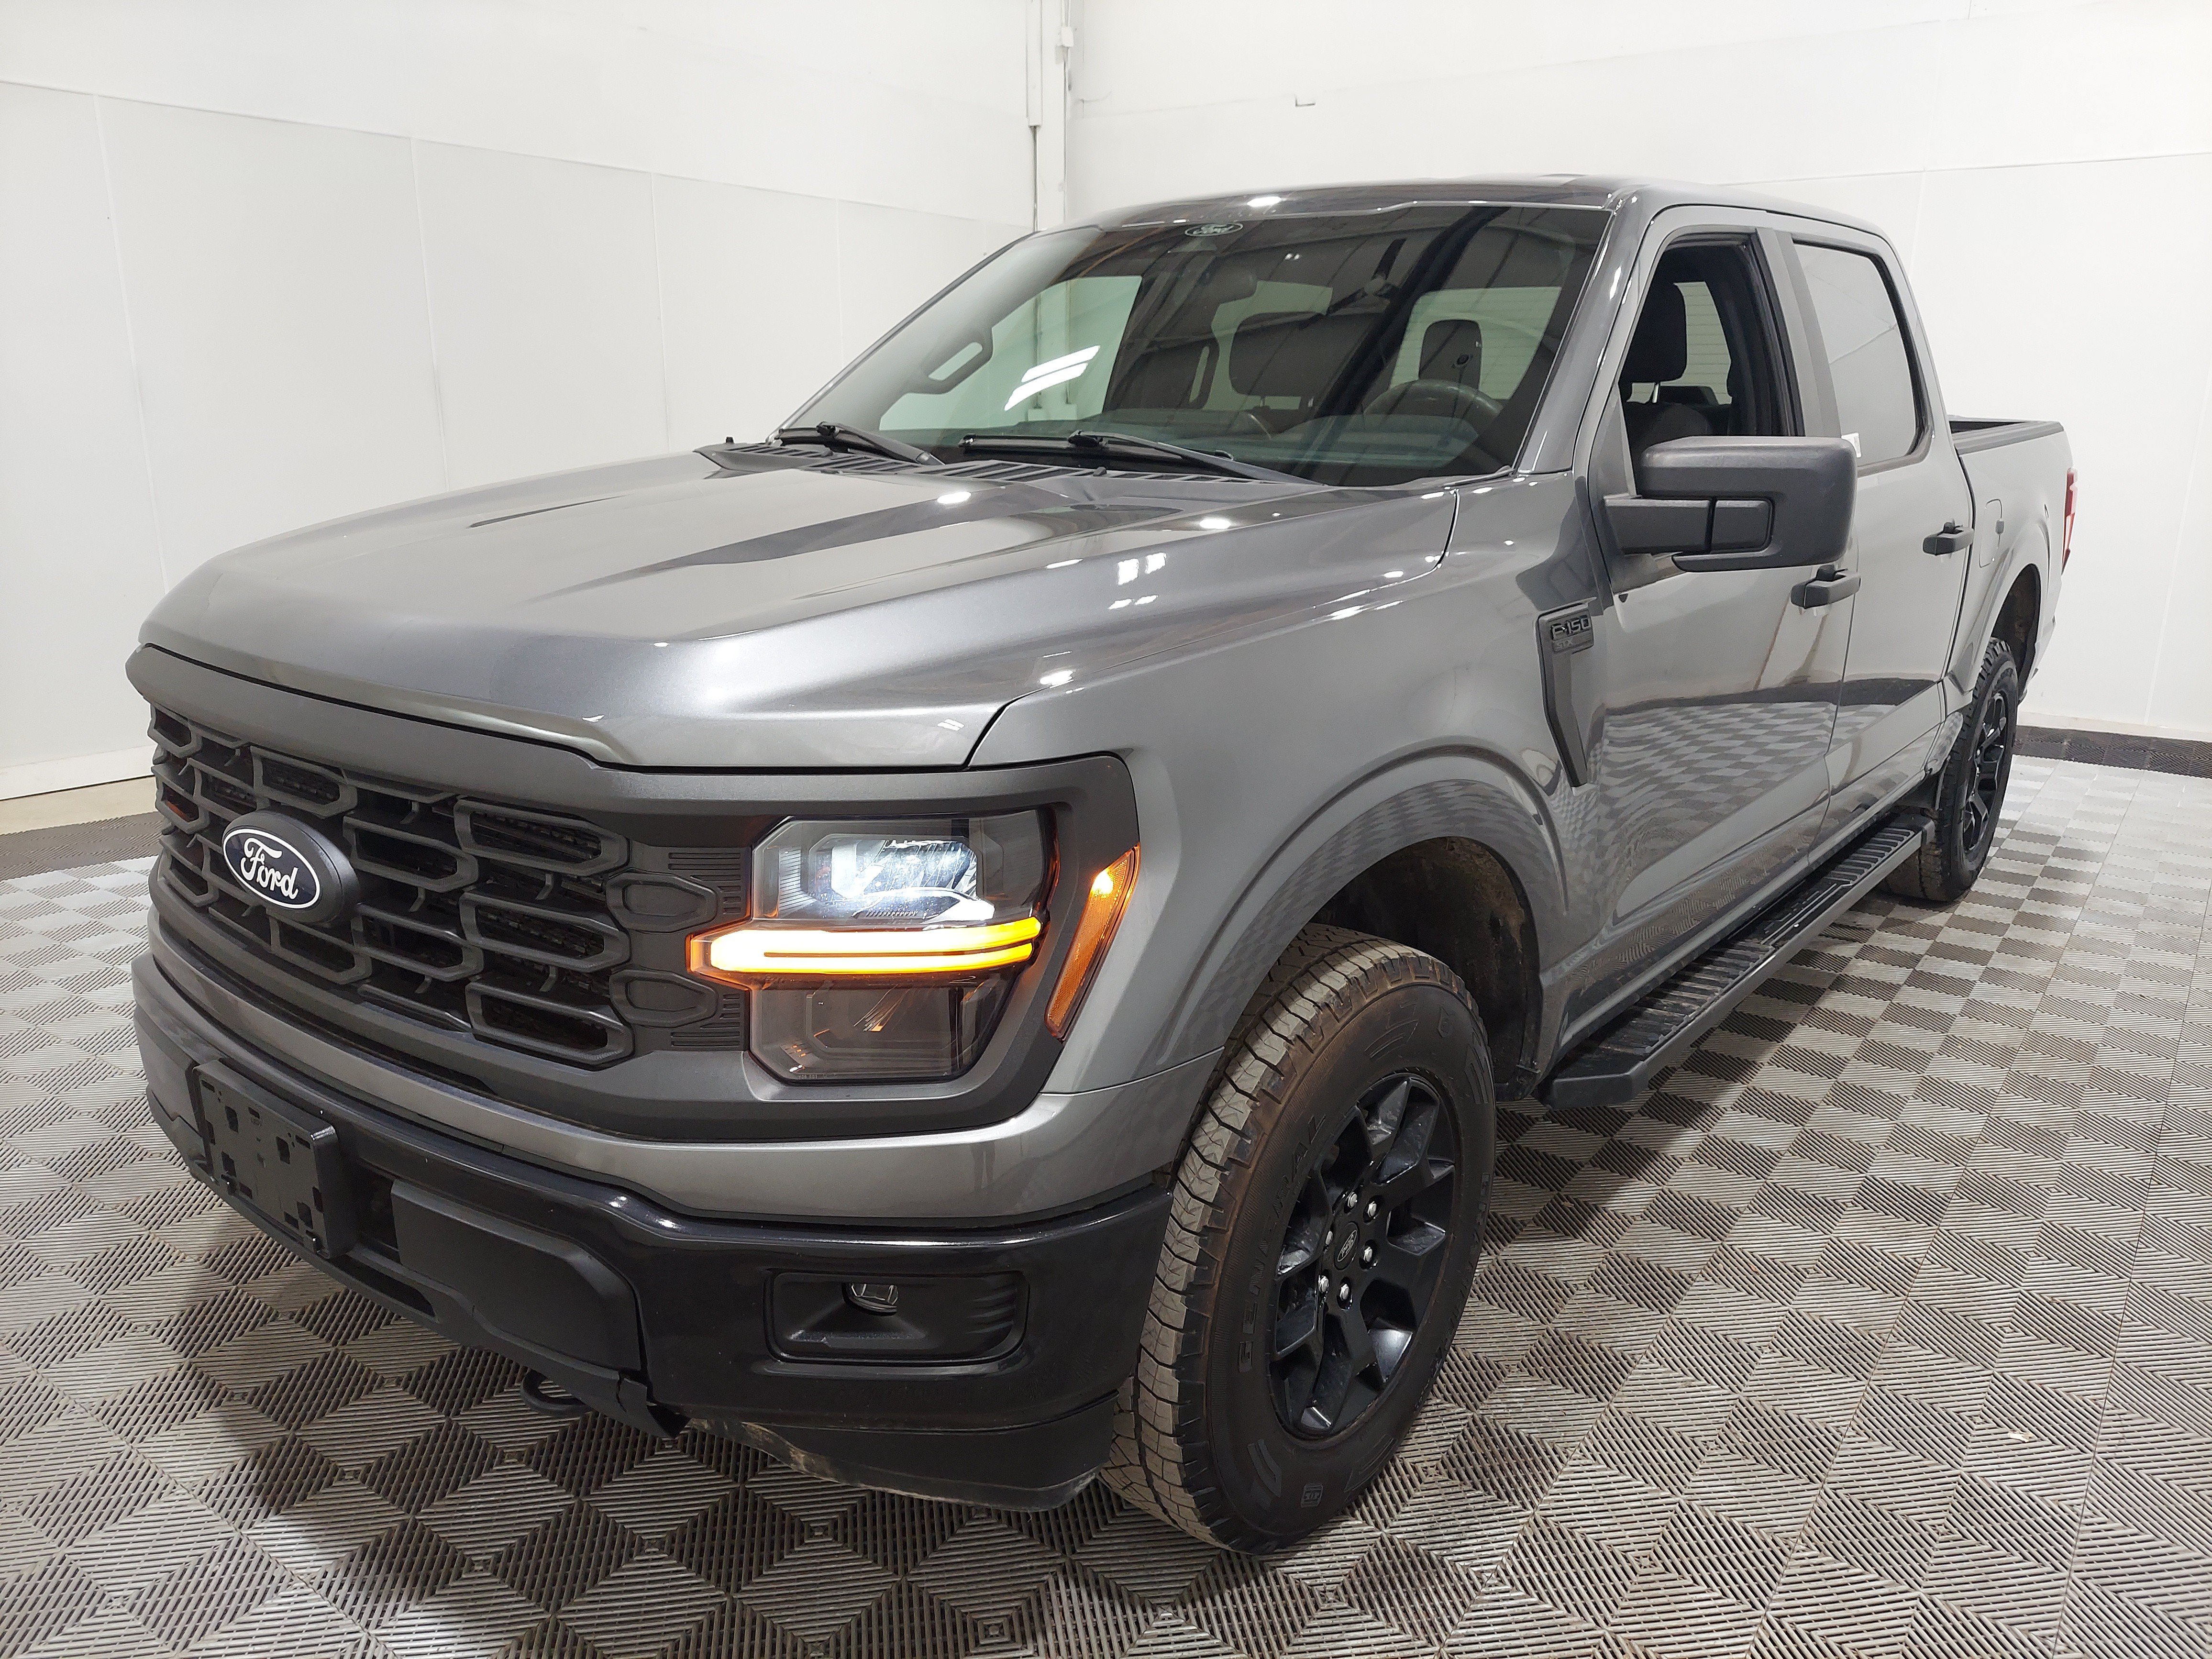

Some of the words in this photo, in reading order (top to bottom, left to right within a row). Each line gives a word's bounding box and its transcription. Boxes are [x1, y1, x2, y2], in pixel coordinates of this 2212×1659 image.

[1193, 224, 1234, 234] Ford
[1551, 615, 1592, 640] F-150
[240, 838, 299, 900] Ford
